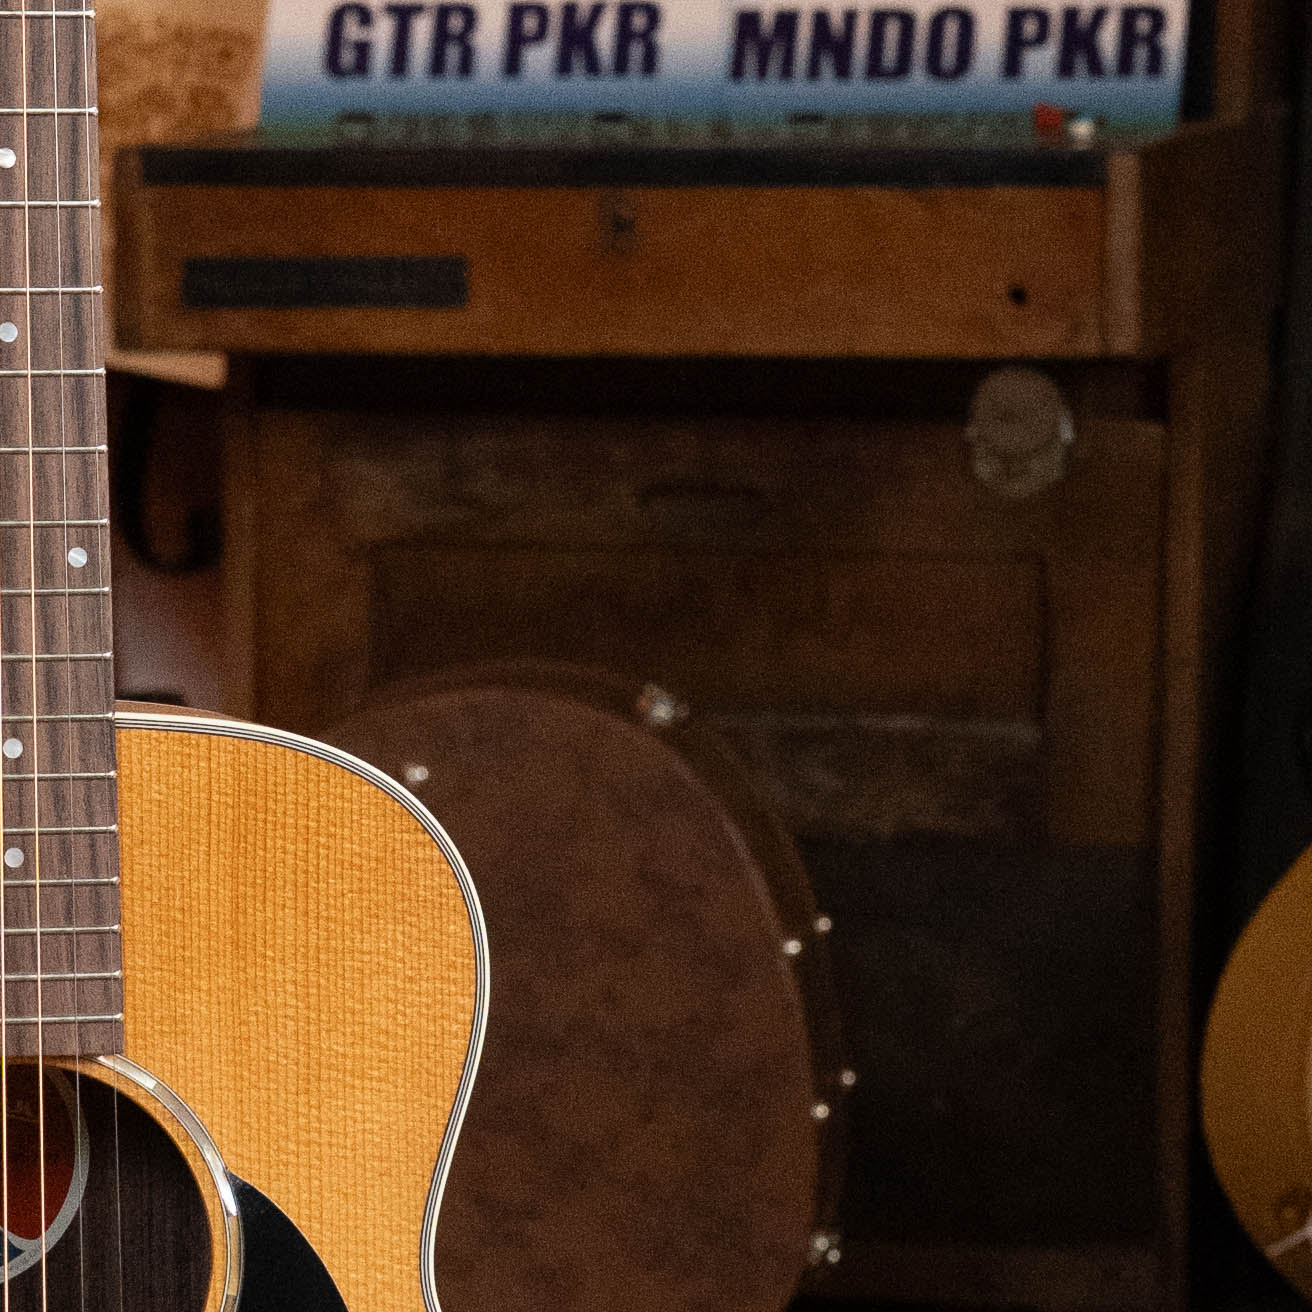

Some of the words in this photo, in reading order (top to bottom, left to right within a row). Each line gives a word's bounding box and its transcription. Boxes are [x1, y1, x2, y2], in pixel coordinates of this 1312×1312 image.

[325, 0, 479, 79] GTR
[502, 0, 663, 79] PKR
[730, 5, 976, 81] MNDO
[999, 3, 1168, 79] PKR
